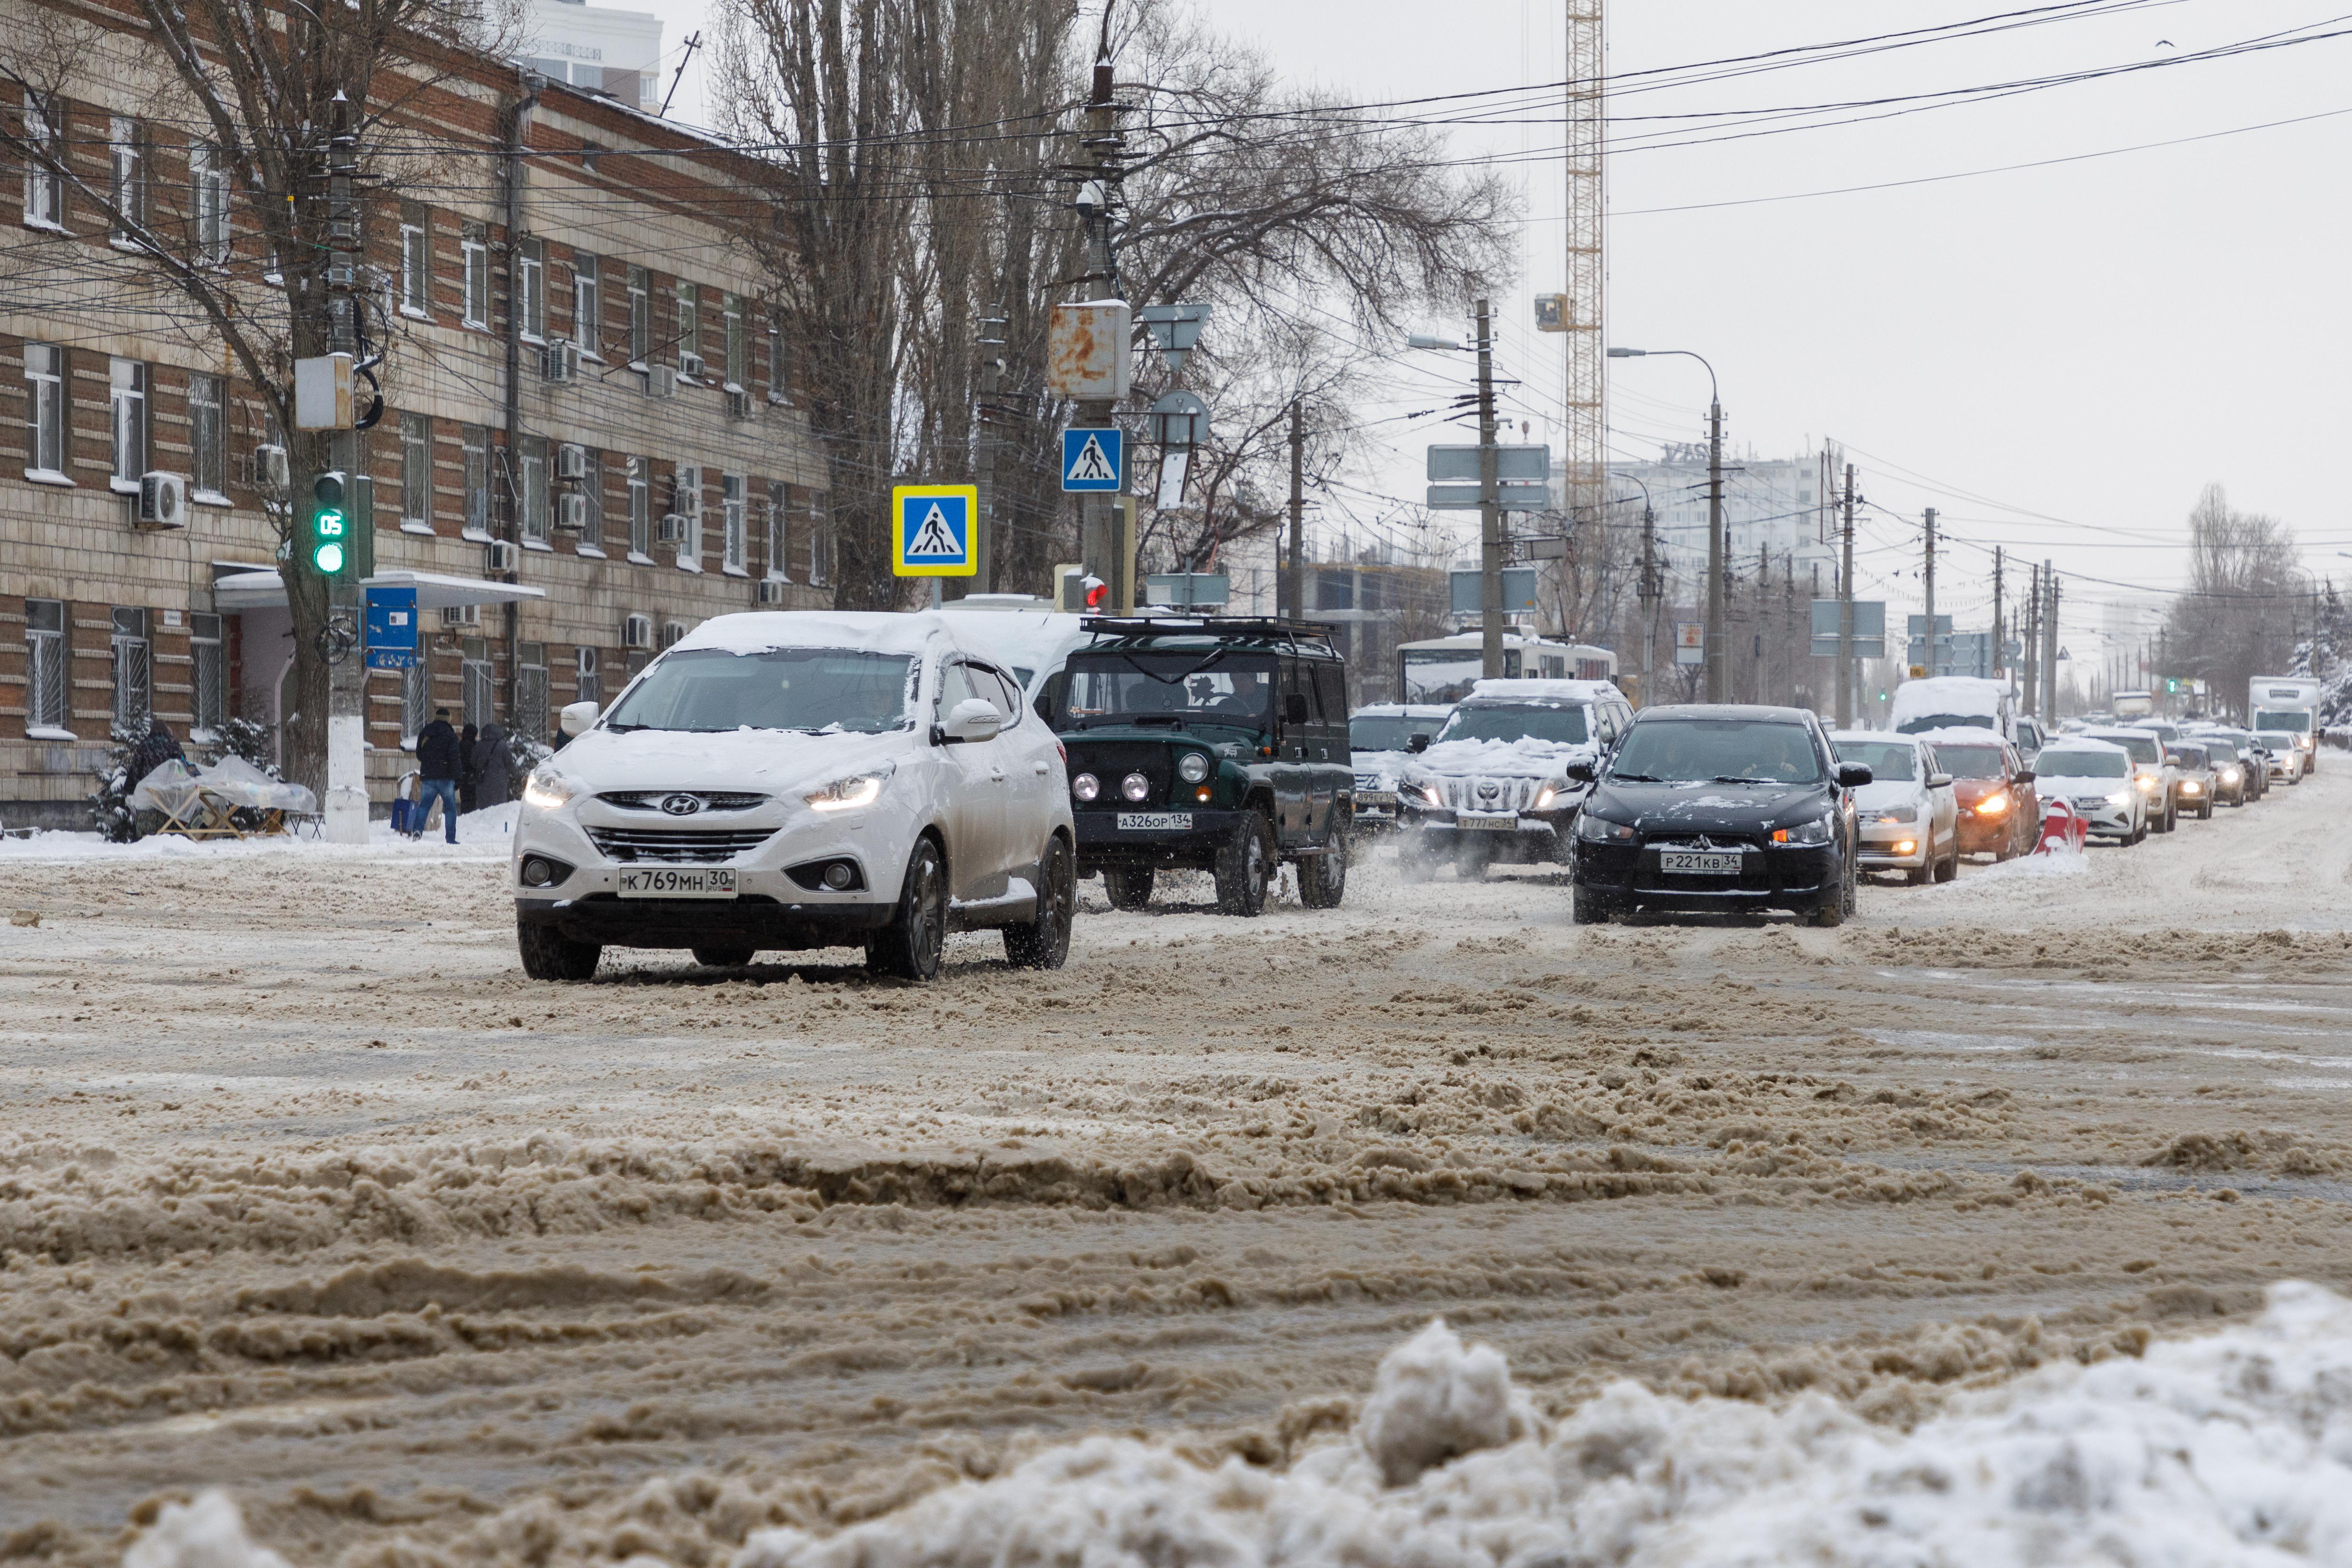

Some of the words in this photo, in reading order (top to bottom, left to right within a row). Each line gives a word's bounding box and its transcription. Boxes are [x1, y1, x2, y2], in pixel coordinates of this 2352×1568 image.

[320, 515, 342, 534] 05
[1122, 815, 1168, 827] А326ОР
[1171, 814, 1189, 824] 134
[1463, 818, 1500, 828] Т777НС
[1666, 855, 1720, 868] Р221КВ
[1724, 855, 1737, 865] 34
[628, 871, 703, 890] К769МН
[709, 871, 729, 885] 30
